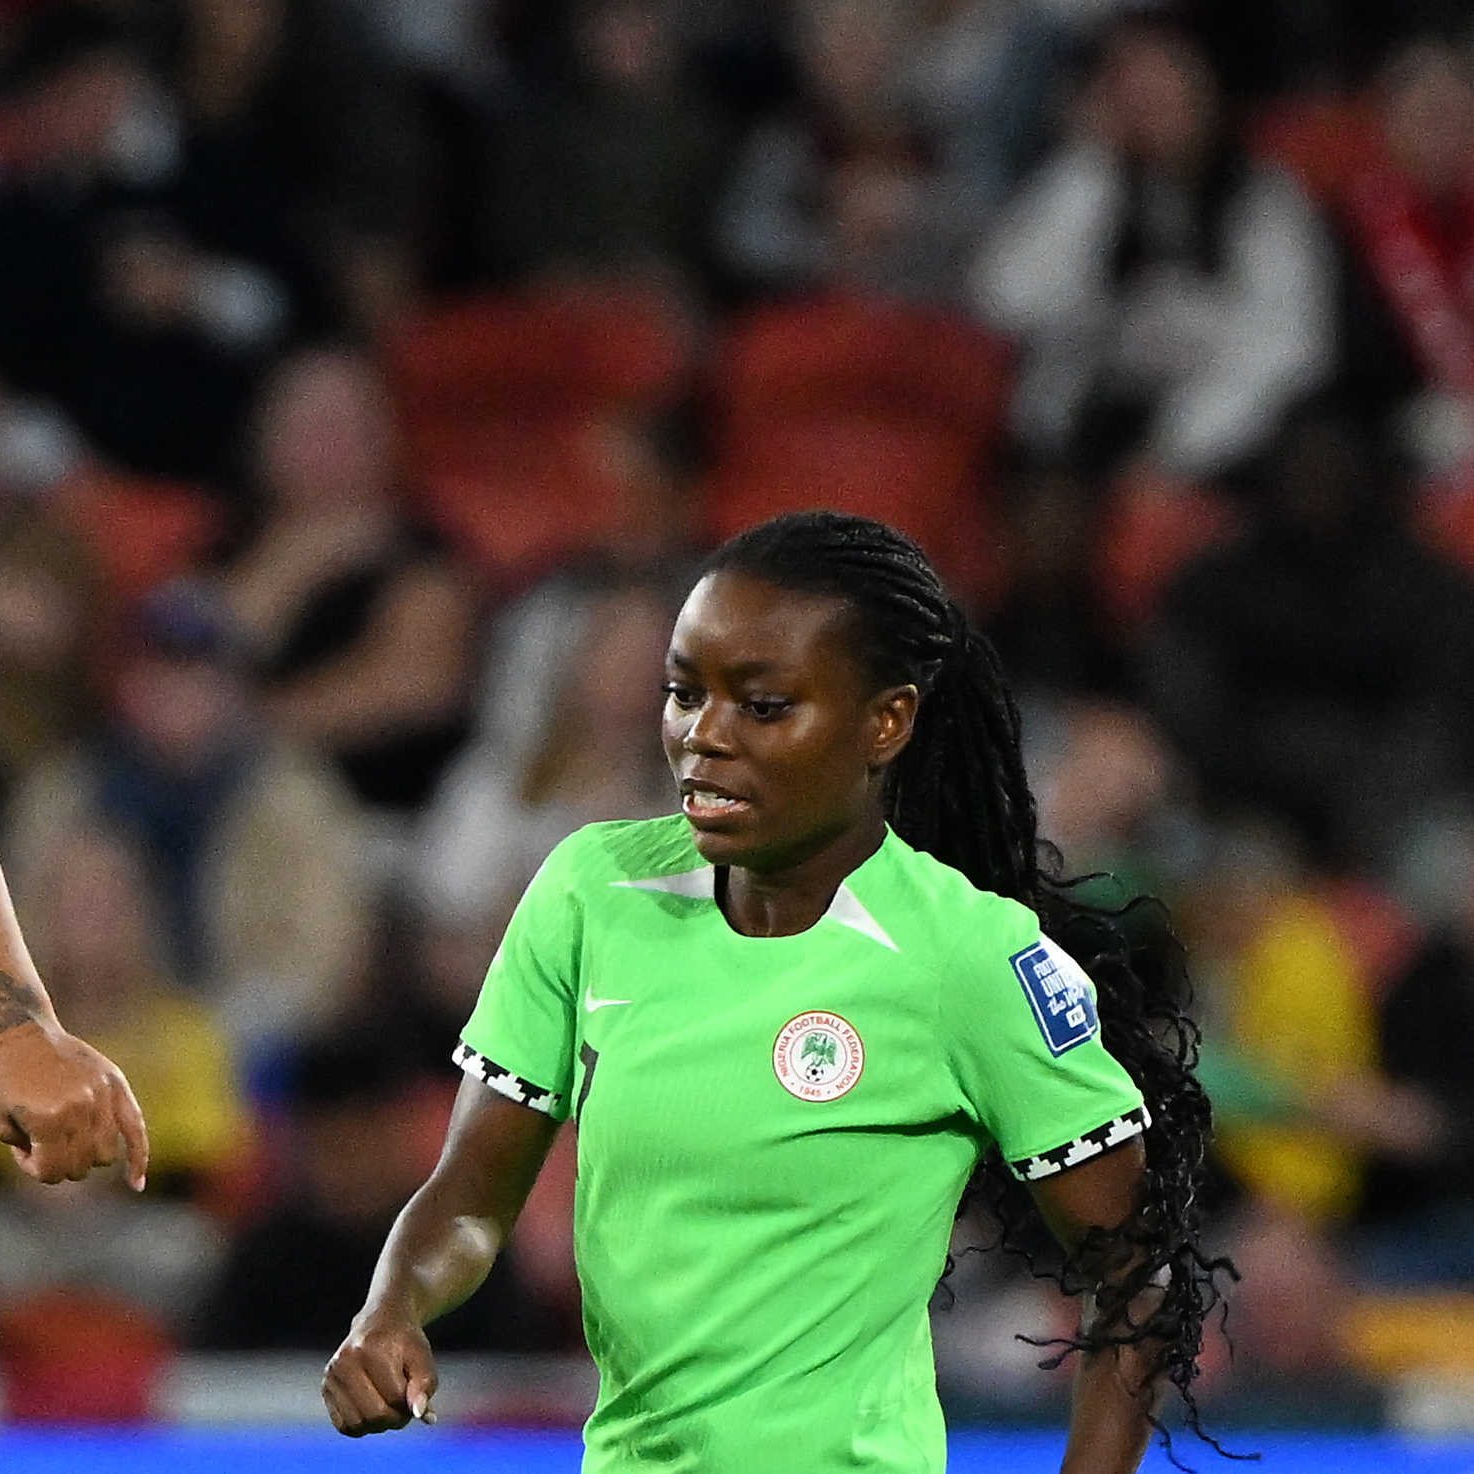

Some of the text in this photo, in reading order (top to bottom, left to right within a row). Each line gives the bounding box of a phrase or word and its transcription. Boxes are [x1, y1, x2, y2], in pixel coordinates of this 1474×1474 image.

[777, 1016, 860, 1090] NIGERIA FOOTBALL FEDERATION
[799, 1085, 822, 1097] 1945
